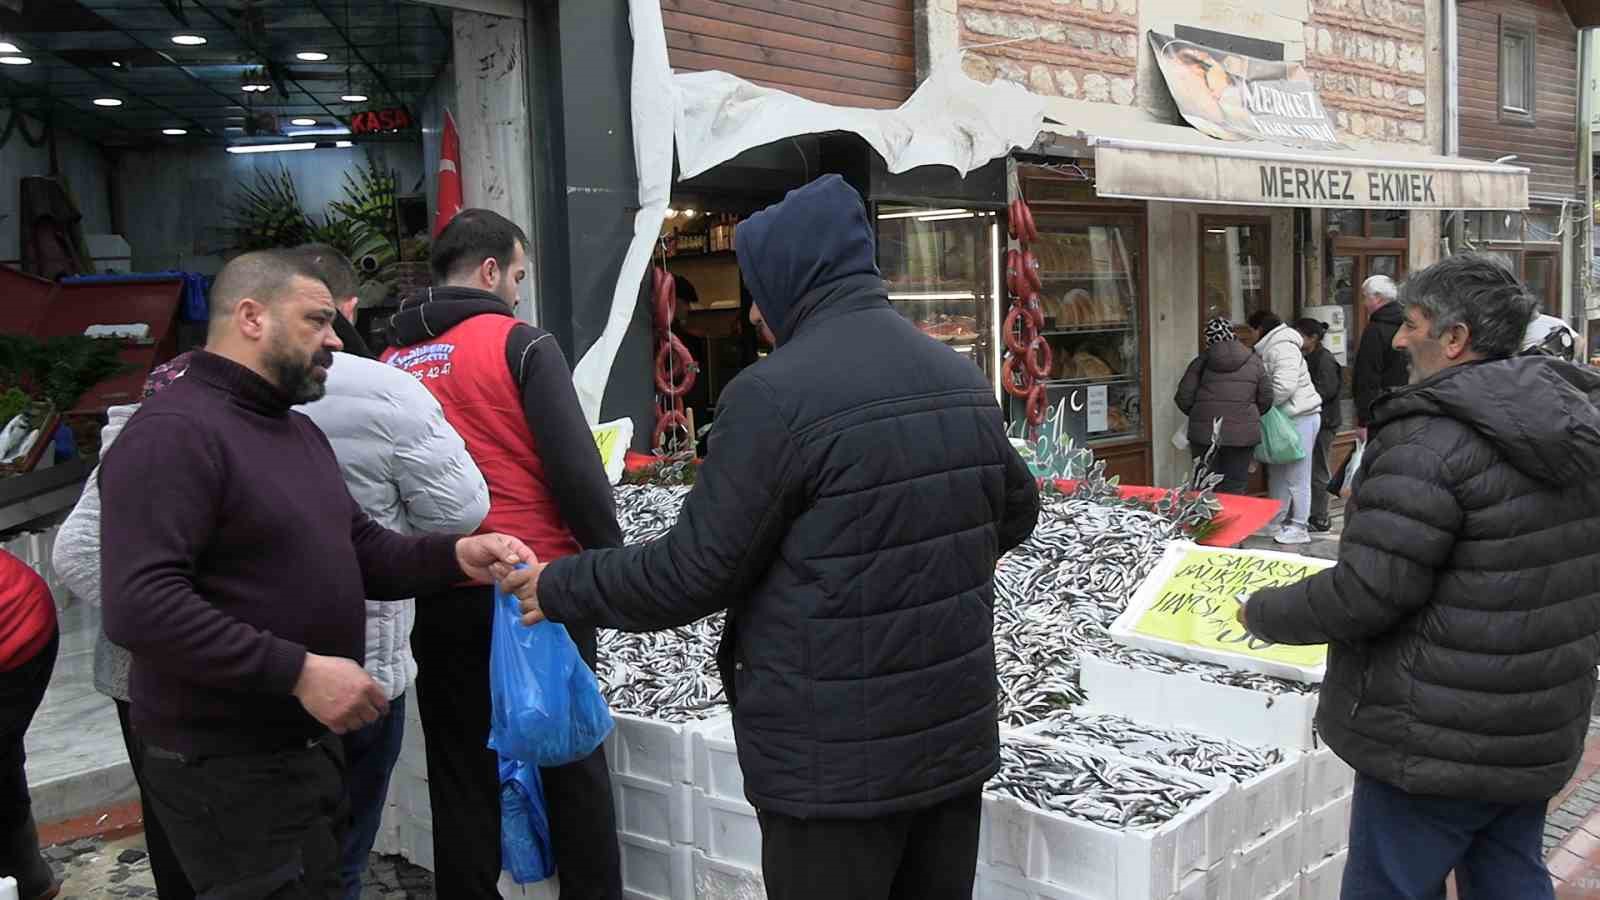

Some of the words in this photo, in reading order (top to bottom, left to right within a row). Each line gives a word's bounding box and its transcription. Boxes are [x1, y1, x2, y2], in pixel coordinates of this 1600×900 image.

[1246, 81, 1325, 119] MERKEZ
[351, 110, 410, 134] KASA
[1260, 165, 1355, 201] MERKEZ
[1368, 172, 1437, 203] EKMEK
[426, 366, 440, 379] 42
